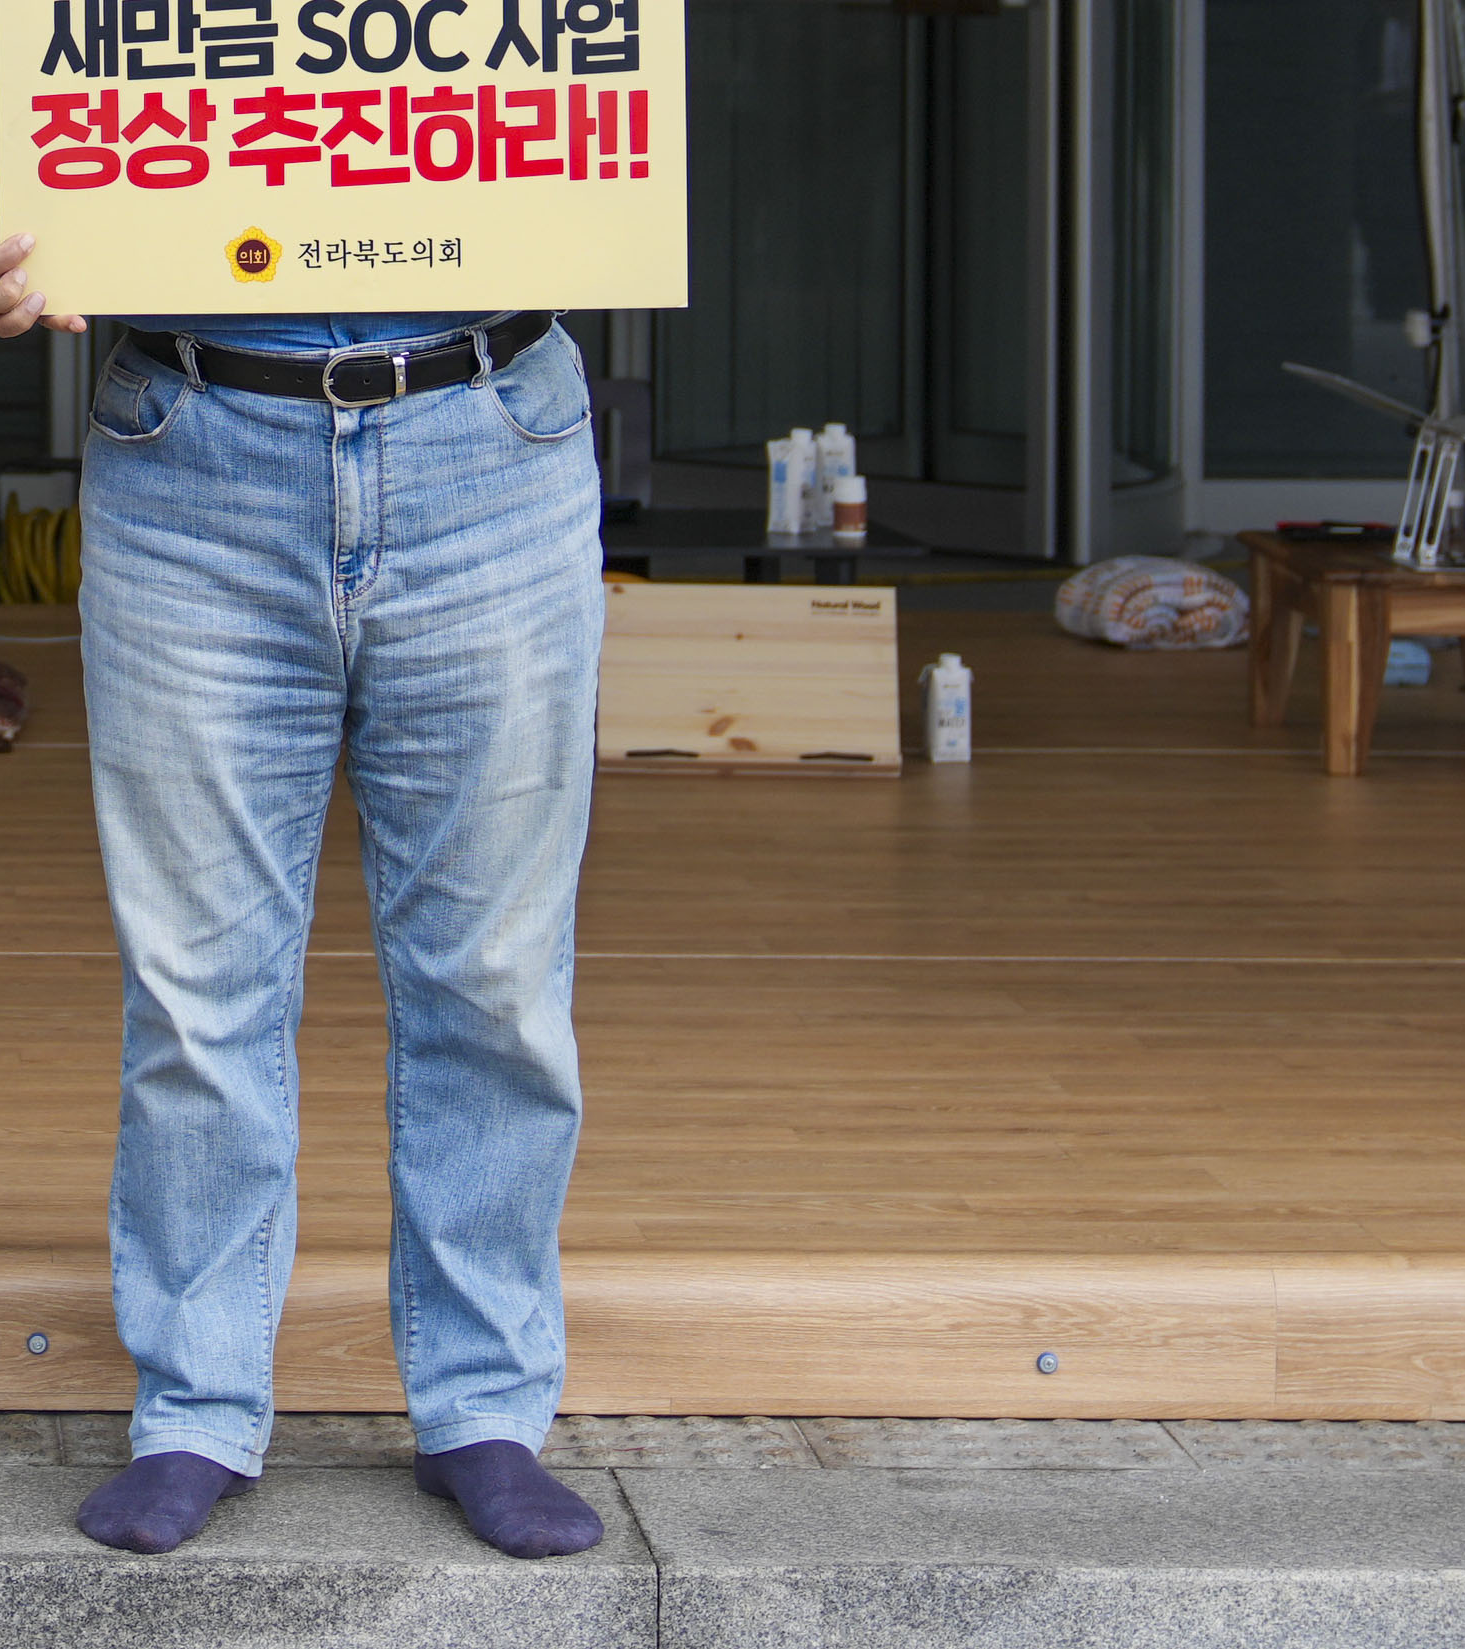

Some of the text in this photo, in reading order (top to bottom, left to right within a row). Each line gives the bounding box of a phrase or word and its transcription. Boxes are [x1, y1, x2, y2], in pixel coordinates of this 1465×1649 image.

[31, 83, 649, 190] 정상 추진하라!!
[238, 248, 267, 264] 의회
[297, 237, 462, 269] 전라북도의회
